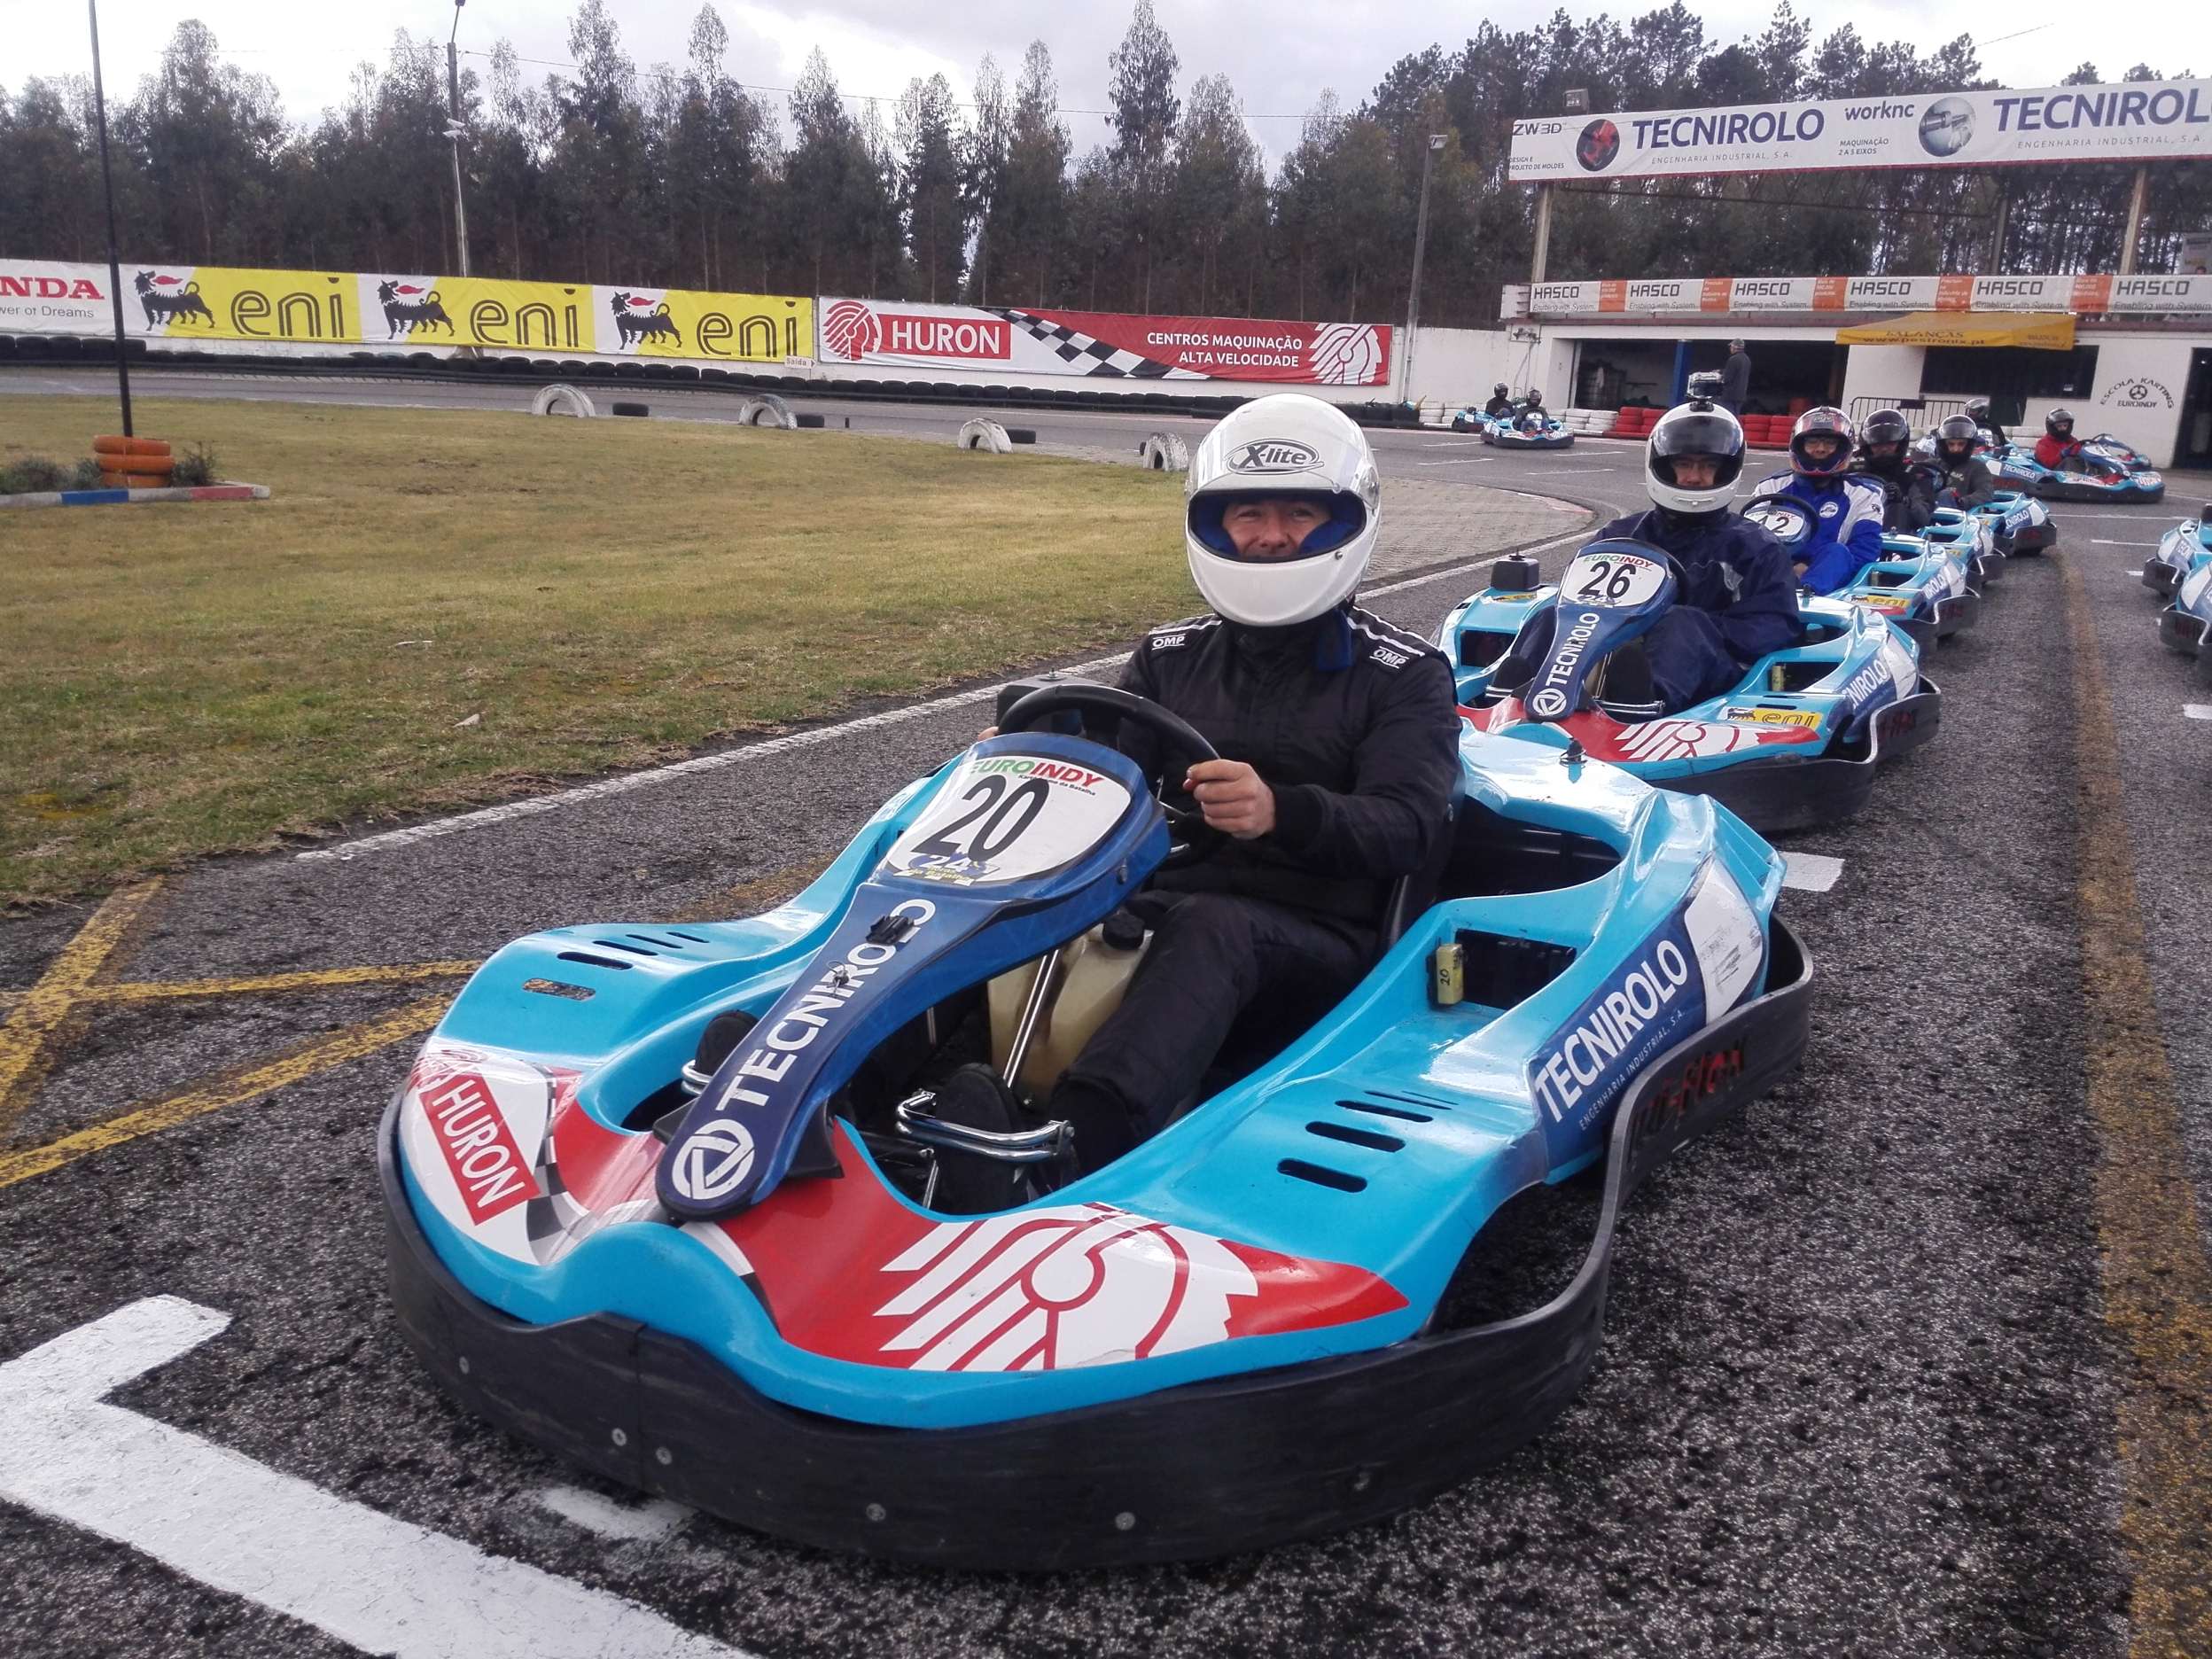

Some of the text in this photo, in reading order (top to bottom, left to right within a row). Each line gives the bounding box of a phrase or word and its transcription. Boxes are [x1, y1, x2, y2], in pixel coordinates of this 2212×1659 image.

[1993, 89, 2212, 132] TECNIROL
[1632, 108, 1825, 149] TECNIROLO
[1840, 136, 1889, 146] MAQUINAÇÃO
[2017, 138, 2092, 149] ENGENHARIA
[1651, 155, 1709, 165] ENGENHARIA
[1534, 285, 1580, 300] HASCO
[1630, 284, 1681, 298] HASCO
[1734, 282, 1791, 296] HASCO
[1850, 281, 1911, 295] HASCO
[1976, 280, 2044, 296] HASCO
[2116, 279, 2191, 295] HASCO
[25, 307, 37, 316] of
[42, 306, 95, 318] Dreams
[230, 276, 346, 339] eni
[470, 288, 579, 348] eni
[697, 300, 798, 358] eni
[891, 320, 1001, 354] HURON
[1147, 332, 1303, 352] CENTROS MAQUINAÇÃO
[1179, 351, 1299, 367] ALTA VELOCIDADE
[2099, 378, 2135, 406] ESCOLA
[1240, 443, 1307, 469] X-lite
[1584, 554, 1654, 568] EUROINDY
[1577, 560, 1637, 599] 26
[1152, 635, 1185, 648] OMP
[1545, 612, 1601, 687] TECNIROLO
[1373, 648, 1407, 666] OMP
[1843, 659, 1888, 709] NIROLO
[971, 757, 1106, 788] EUROINDY
[1069, 783, 1096, 796] Batalha
[910, 774, 1050, 862] 20
[1534, 939, 1688, 1124] TECNIROLO
[1578, 1073, 1626, 1131] ENGENHARIA
[432, 1079, 526, 1209] HURON
